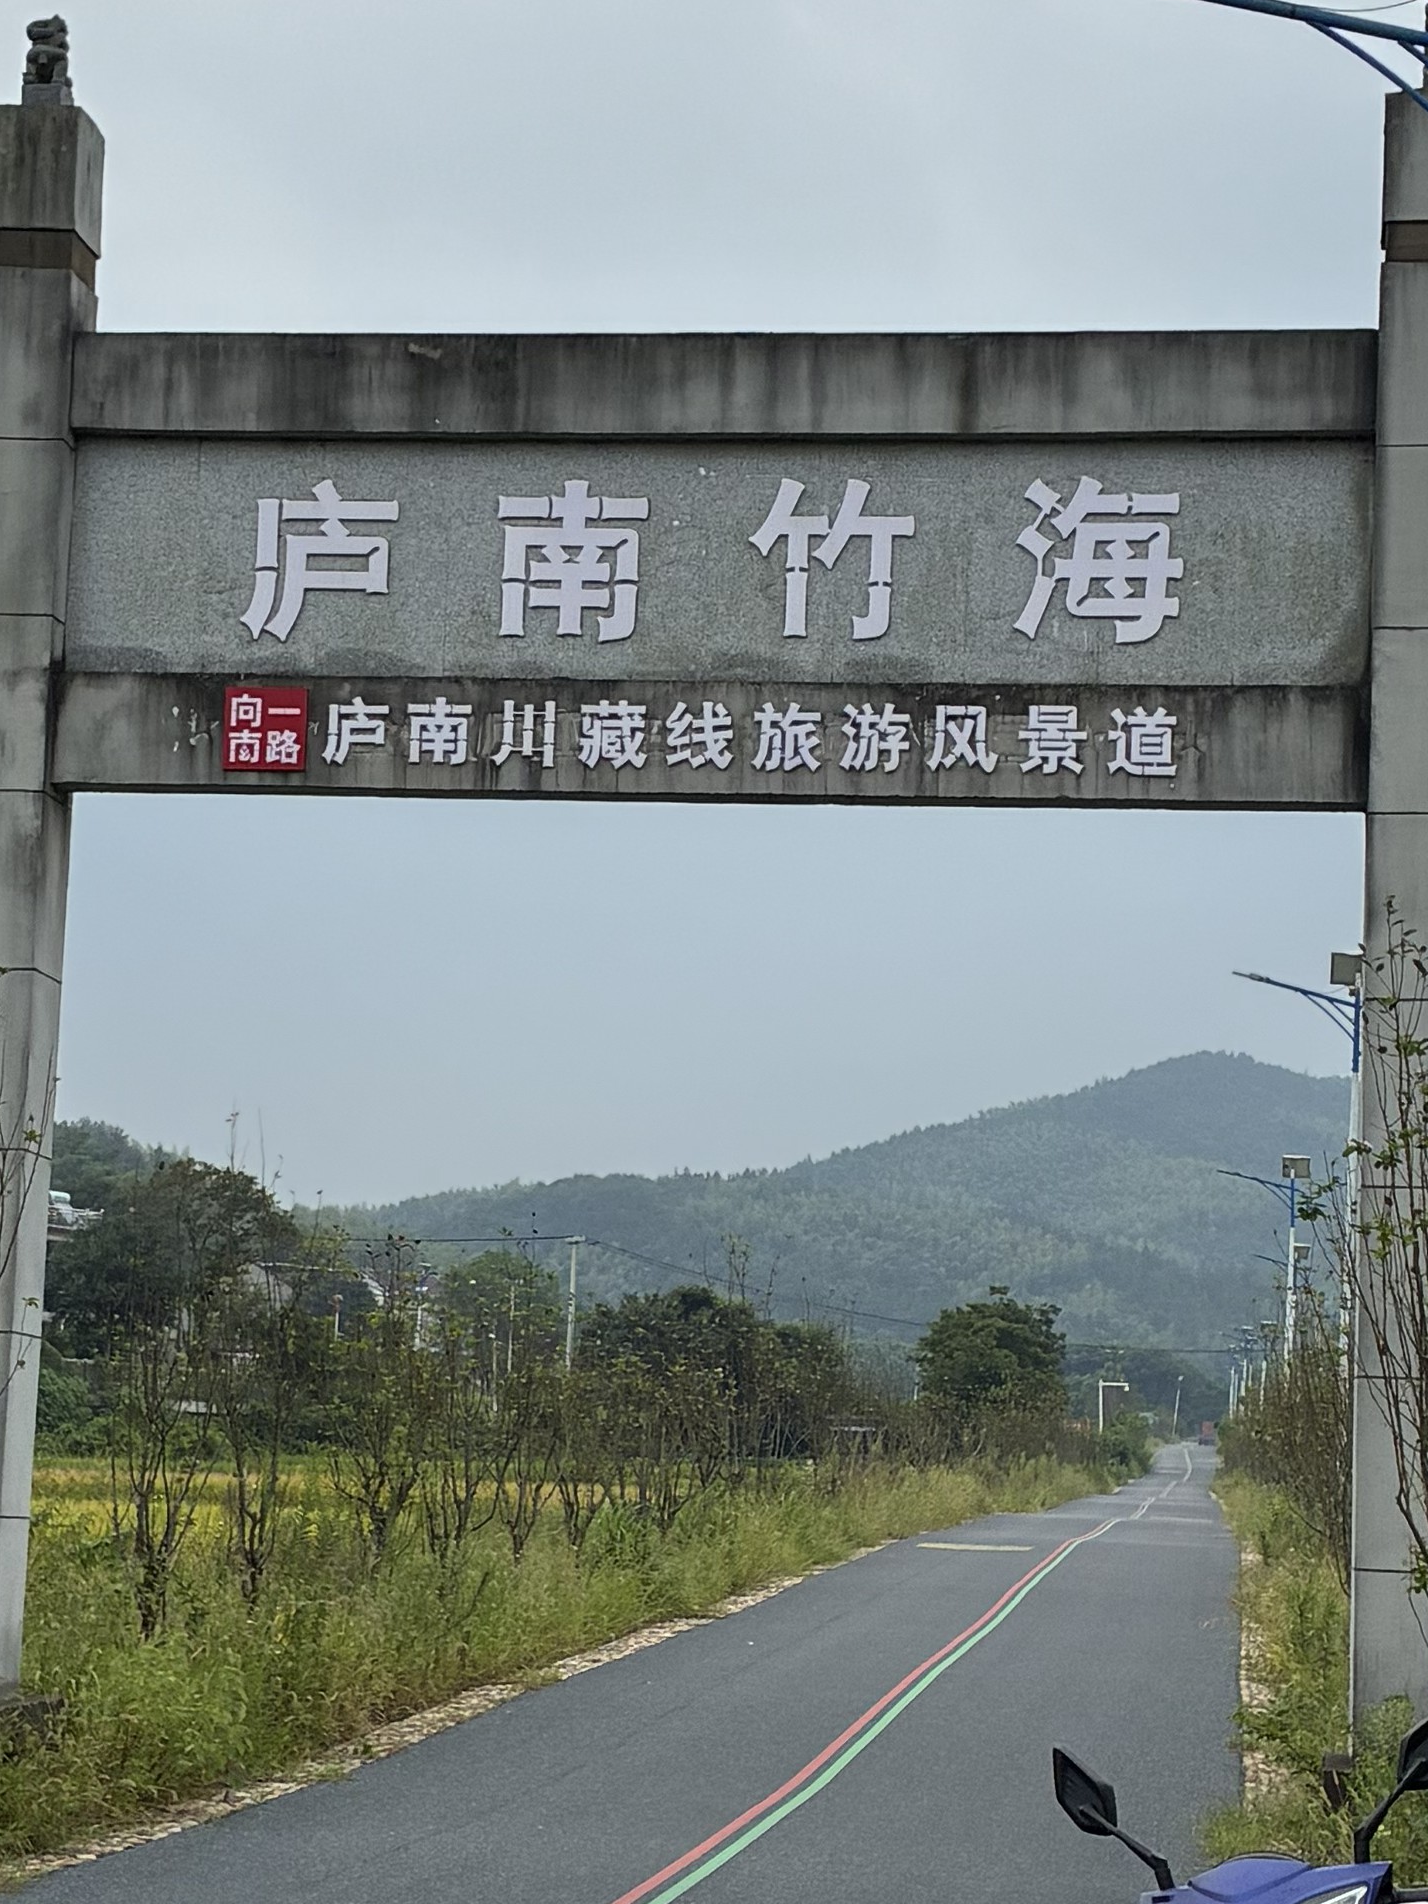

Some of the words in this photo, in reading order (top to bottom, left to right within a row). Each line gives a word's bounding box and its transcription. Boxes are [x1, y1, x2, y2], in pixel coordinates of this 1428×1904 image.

[239, 474, 1185, 645] 庐南竹海
[321, 696, 1178, 778] 庐南川藏线旅游风景道
